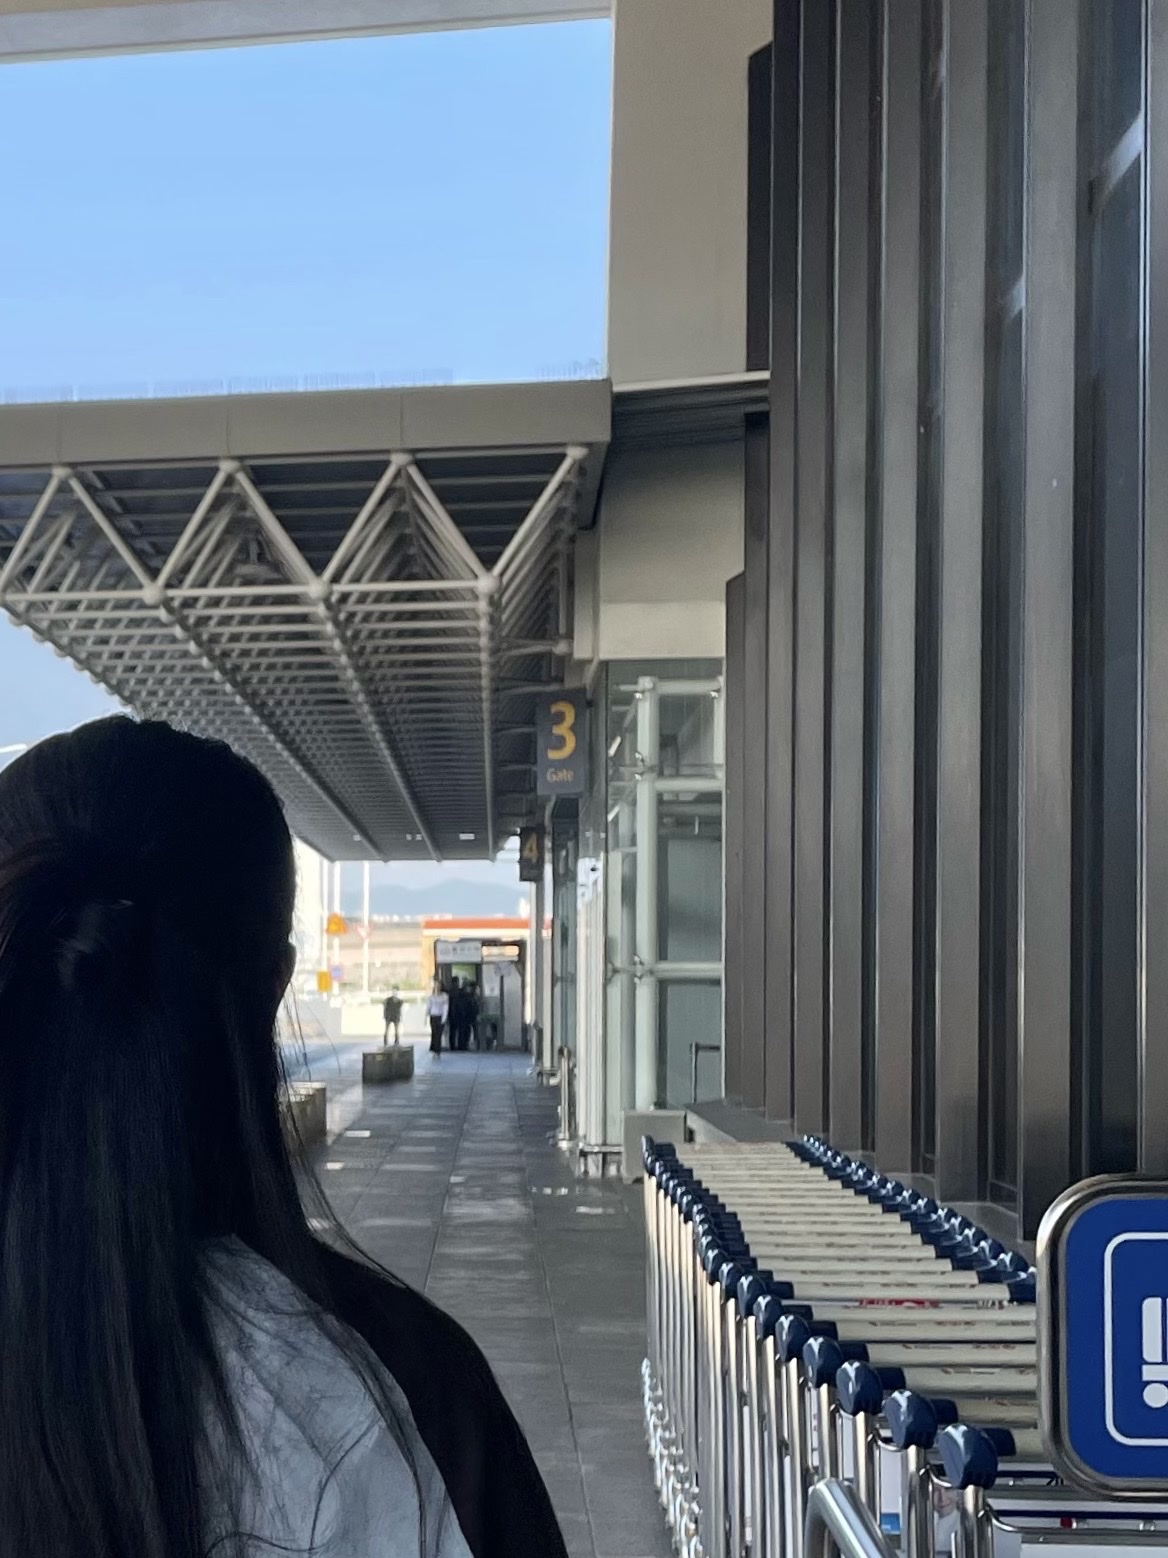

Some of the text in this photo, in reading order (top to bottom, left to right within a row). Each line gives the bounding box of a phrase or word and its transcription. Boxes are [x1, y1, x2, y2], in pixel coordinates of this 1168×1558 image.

[547, 701, 576, 760] 3
[547, 768, 574, 783] Gate
[522, 832, 538, 863] 4
